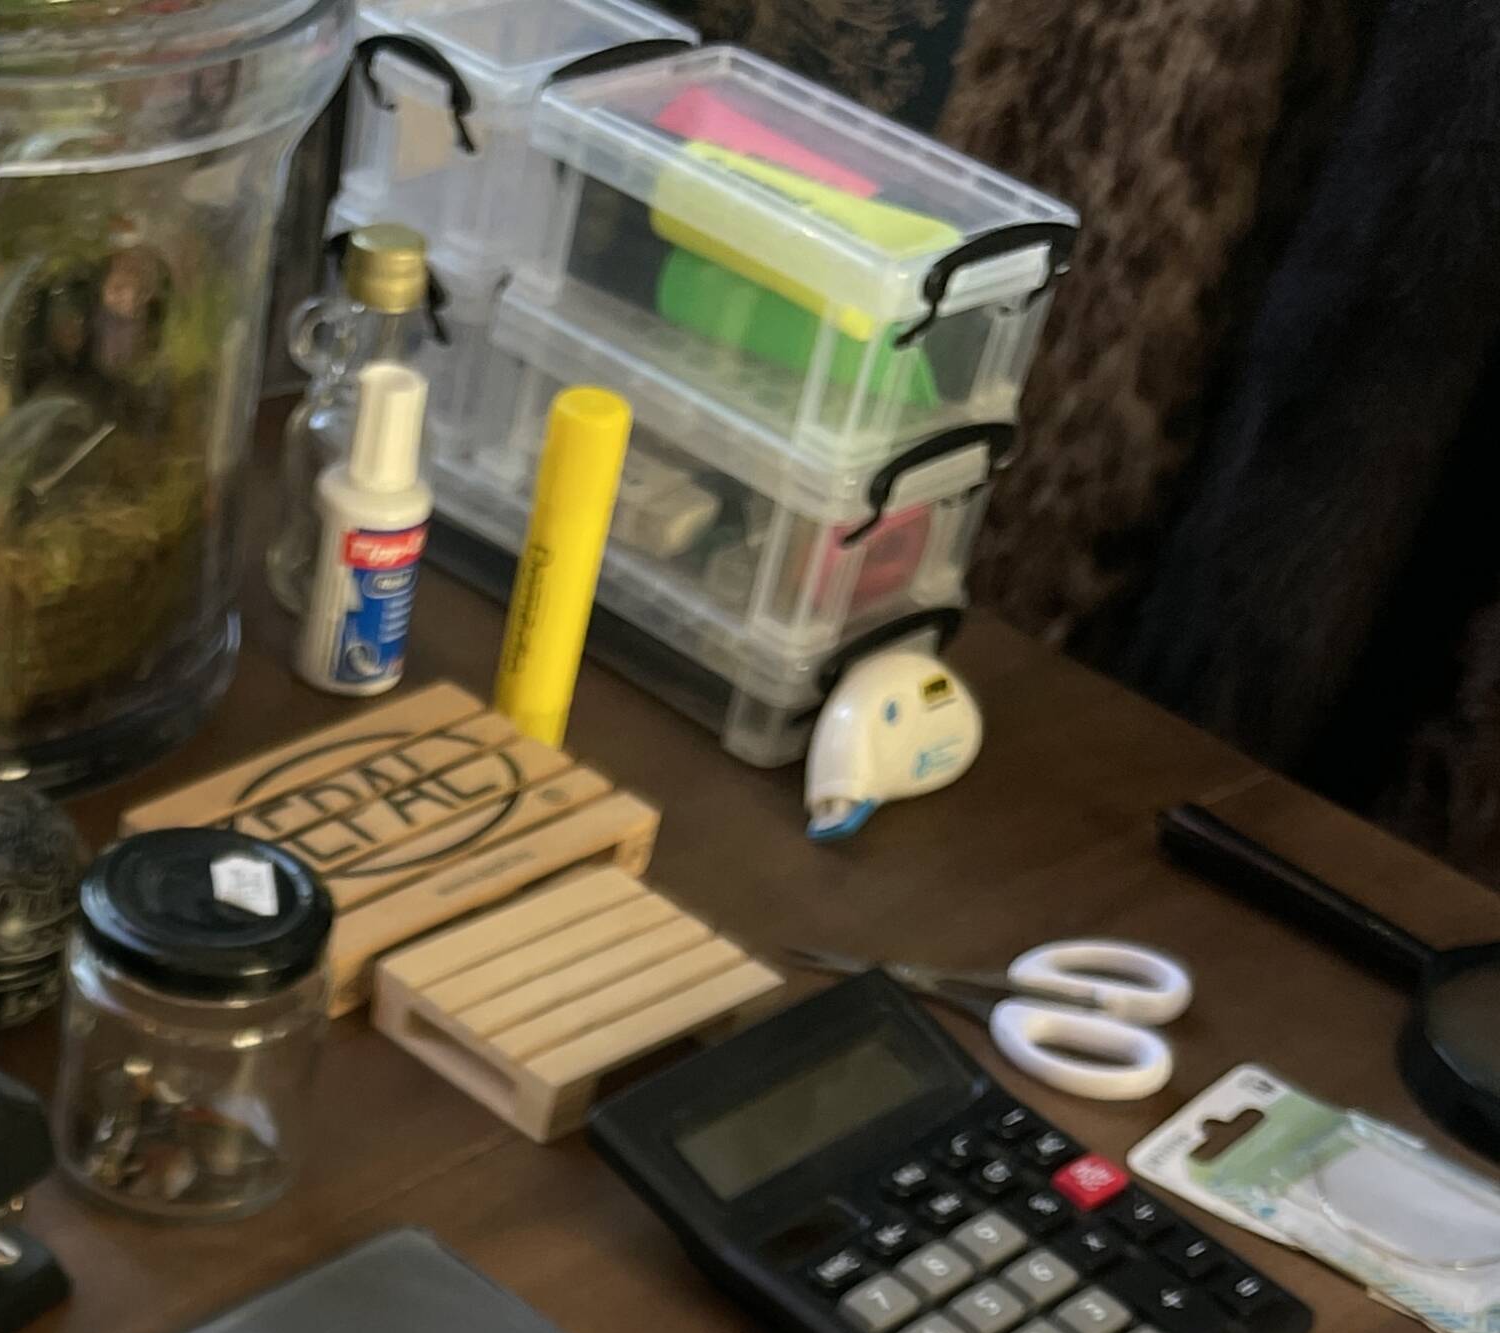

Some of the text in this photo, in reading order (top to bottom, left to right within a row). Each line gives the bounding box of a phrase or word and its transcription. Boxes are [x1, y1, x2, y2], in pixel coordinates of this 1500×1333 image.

[1026, 1260, 1056, 1284] 6
[865, 1289, 892, 1312] 7
[974, 1293, 1001, 1317] 5
[1080, 1300, 1108, 1322] 3
